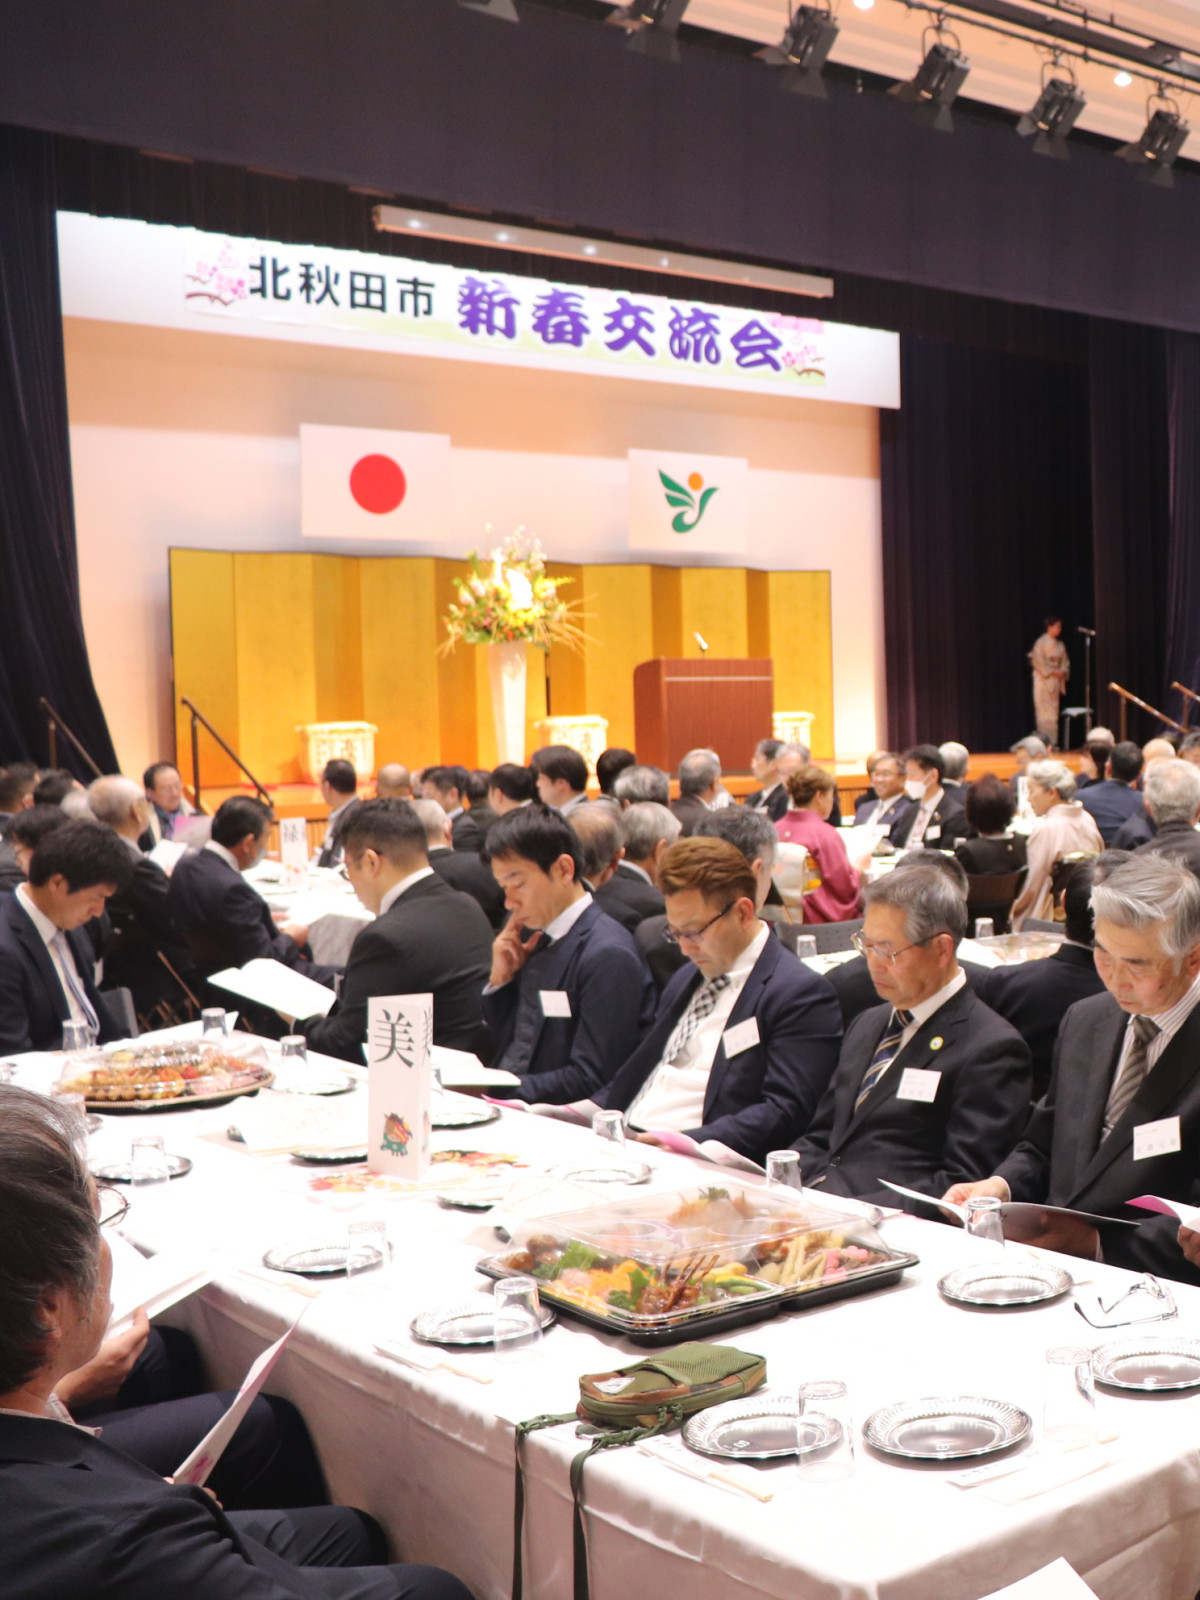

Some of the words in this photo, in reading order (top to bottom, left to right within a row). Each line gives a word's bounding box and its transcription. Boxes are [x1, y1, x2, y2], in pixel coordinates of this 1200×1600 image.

[249, 256, 436, 318] 北秋田市
[457, 276, 783, 372] 新春交流会
[373, 1008, 415, 1069] 美
